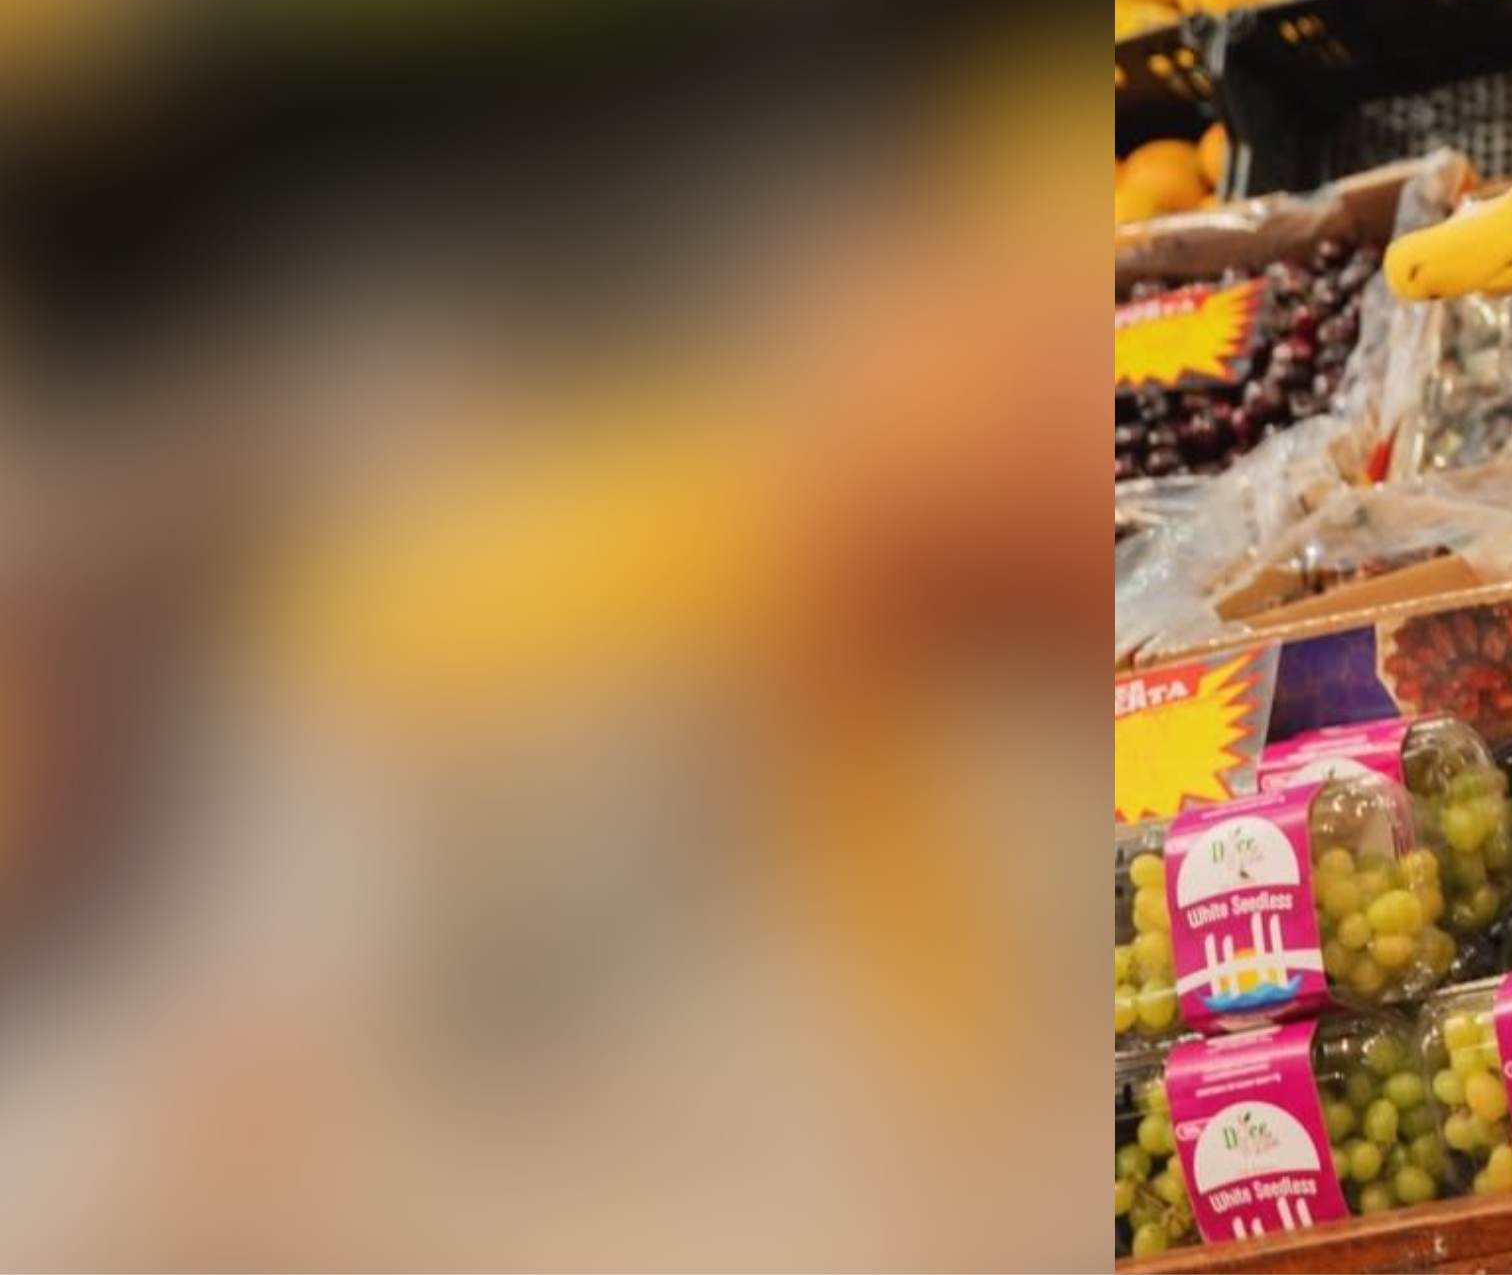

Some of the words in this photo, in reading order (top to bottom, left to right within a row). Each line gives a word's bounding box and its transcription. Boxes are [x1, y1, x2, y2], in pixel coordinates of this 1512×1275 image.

[1187, 902, 1228, 929] White
[1231, 891, 1293, 915] Seedless
[1209, 1186, 1252, 1214] White
[1253, 1176, 1317, 1200] Seedless
